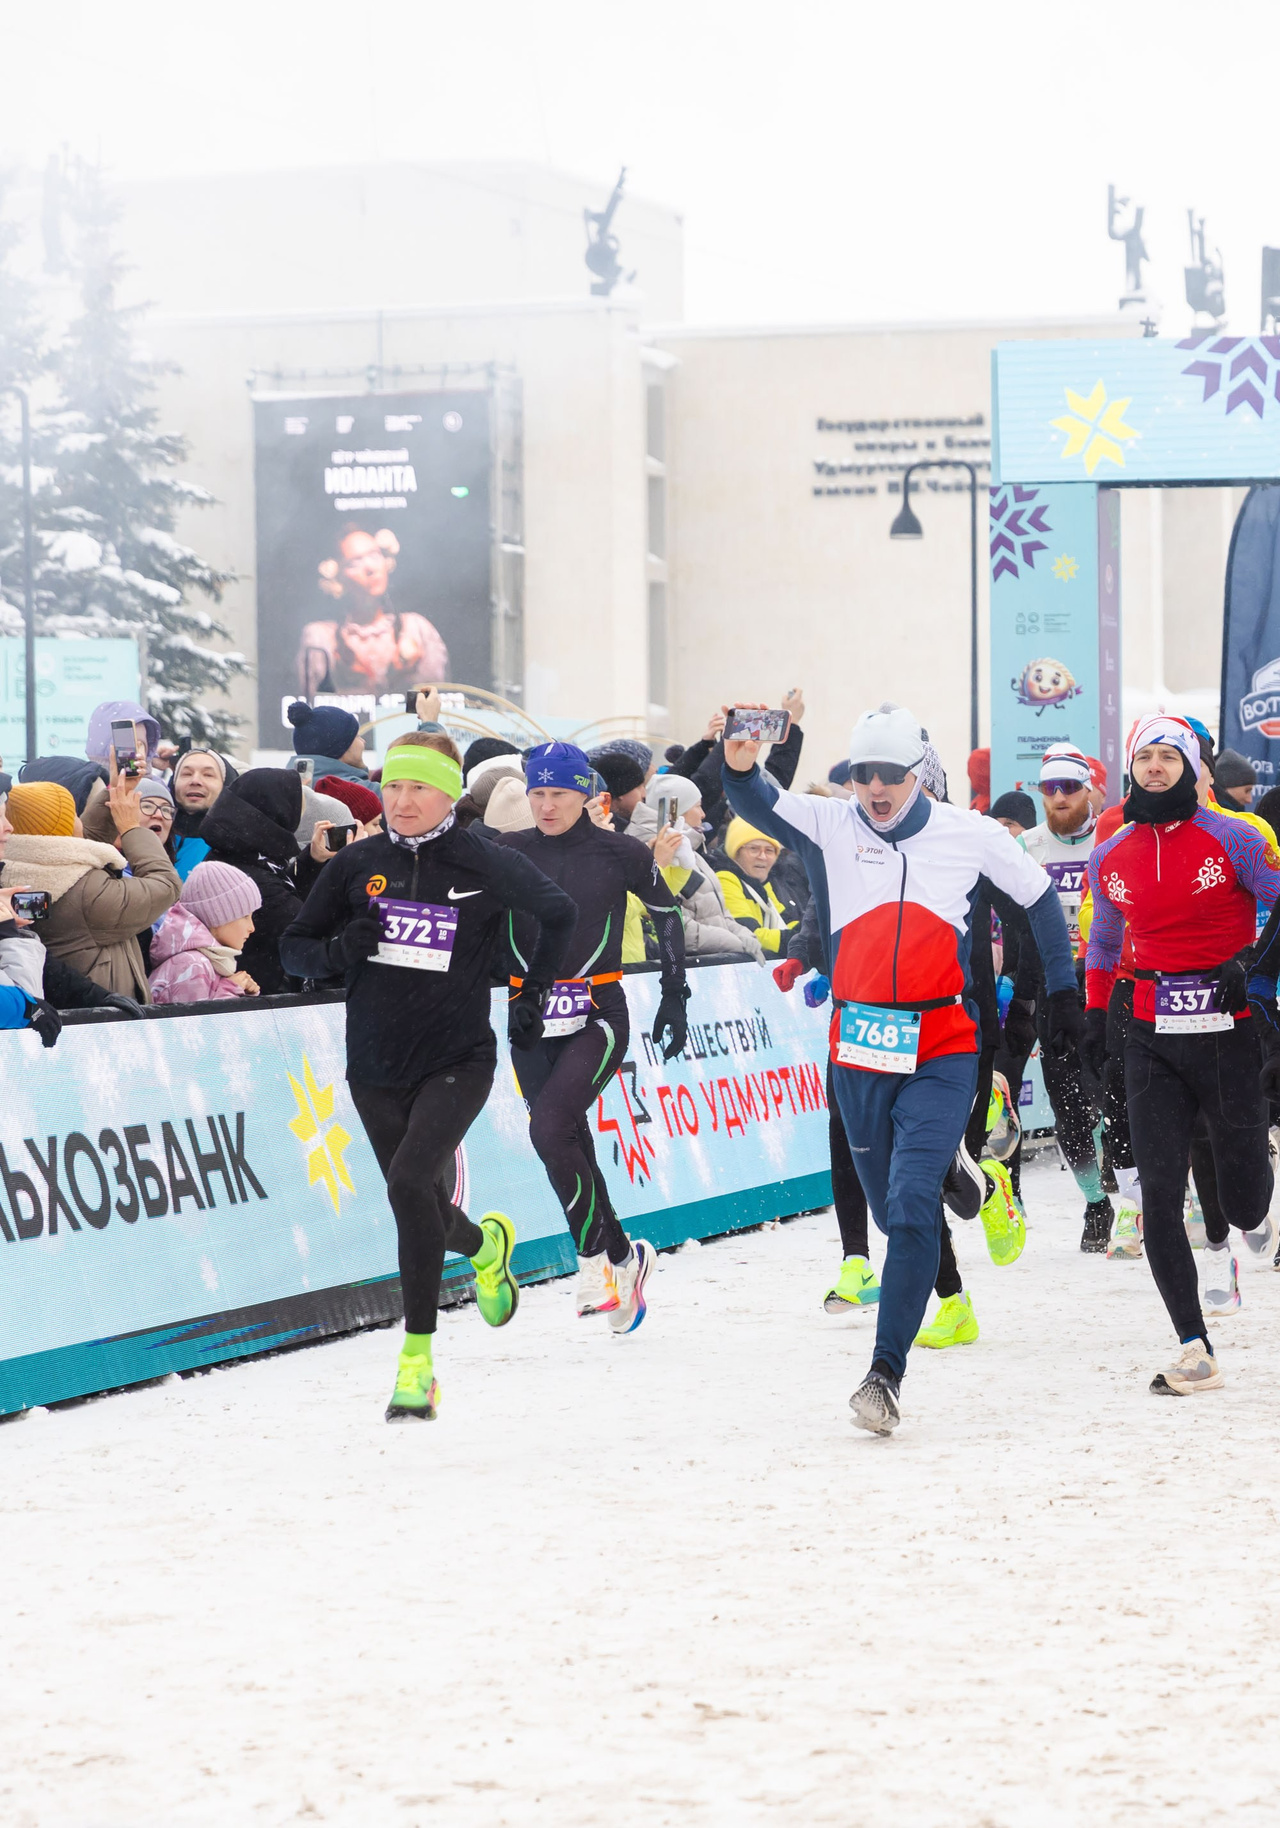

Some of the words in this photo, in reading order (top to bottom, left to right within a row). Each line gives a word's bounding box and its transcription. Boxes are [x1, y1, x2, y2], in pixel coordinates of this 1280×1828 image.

[324, 465, 417, 494] ИОЛАНТА
[865, 847, 883, 855] ЭТОН
[1060, 872, 1084, 889] 47
[384, 915, 432, 944] 372
[1169, 988, 1212, 1011] 337
[855, 1018, 899, 1048] 768
[657, 1083, 700, 1139] ПО
[699, 1061, 829, 1139] УДМУРТИИ
